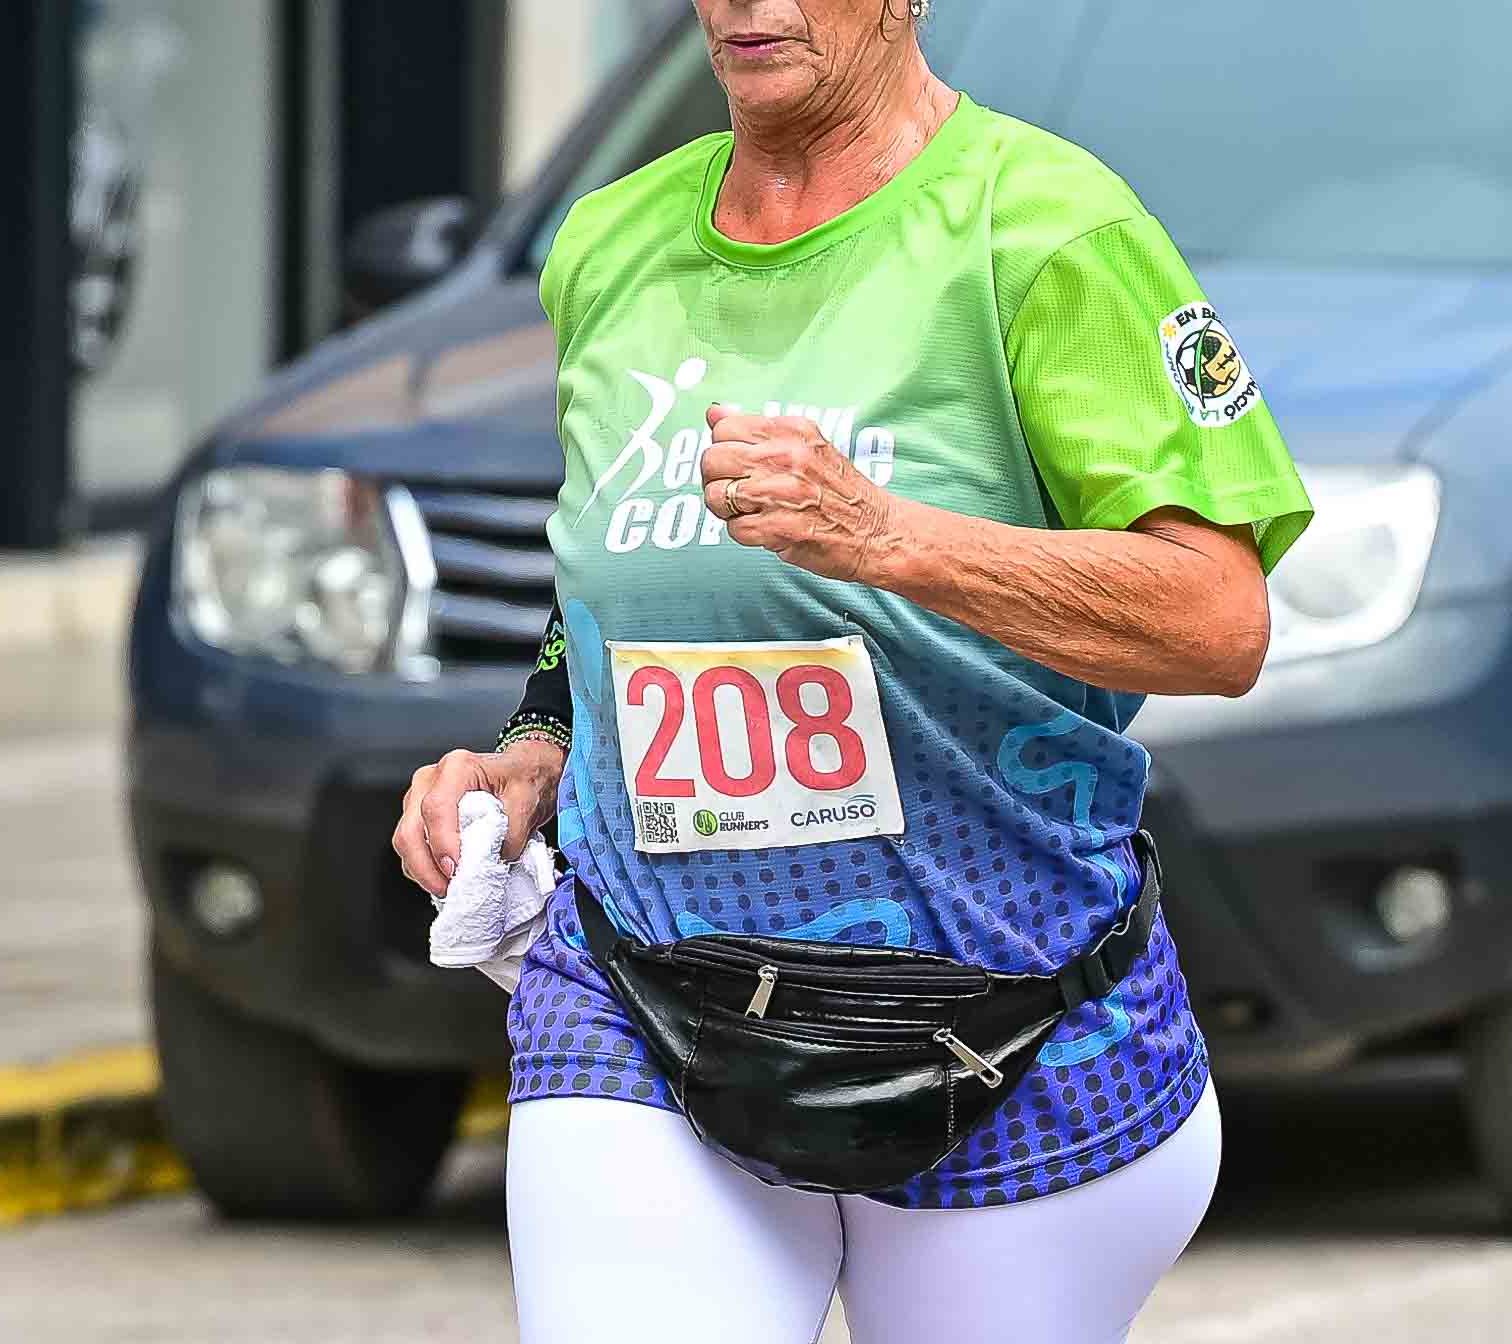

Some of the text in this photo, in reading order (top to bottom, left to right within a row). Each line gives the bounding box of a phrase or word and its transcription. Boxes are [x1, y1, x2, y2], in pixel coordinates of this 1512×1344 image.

[1175, 307, 1198, 327] EN
[626, 664, 867, 798] 208
[718, 811, 745, 822] CLUB
[719, 819, 769, 832] RUNNER'S
[790, 804, 876, 827] CARUSO
